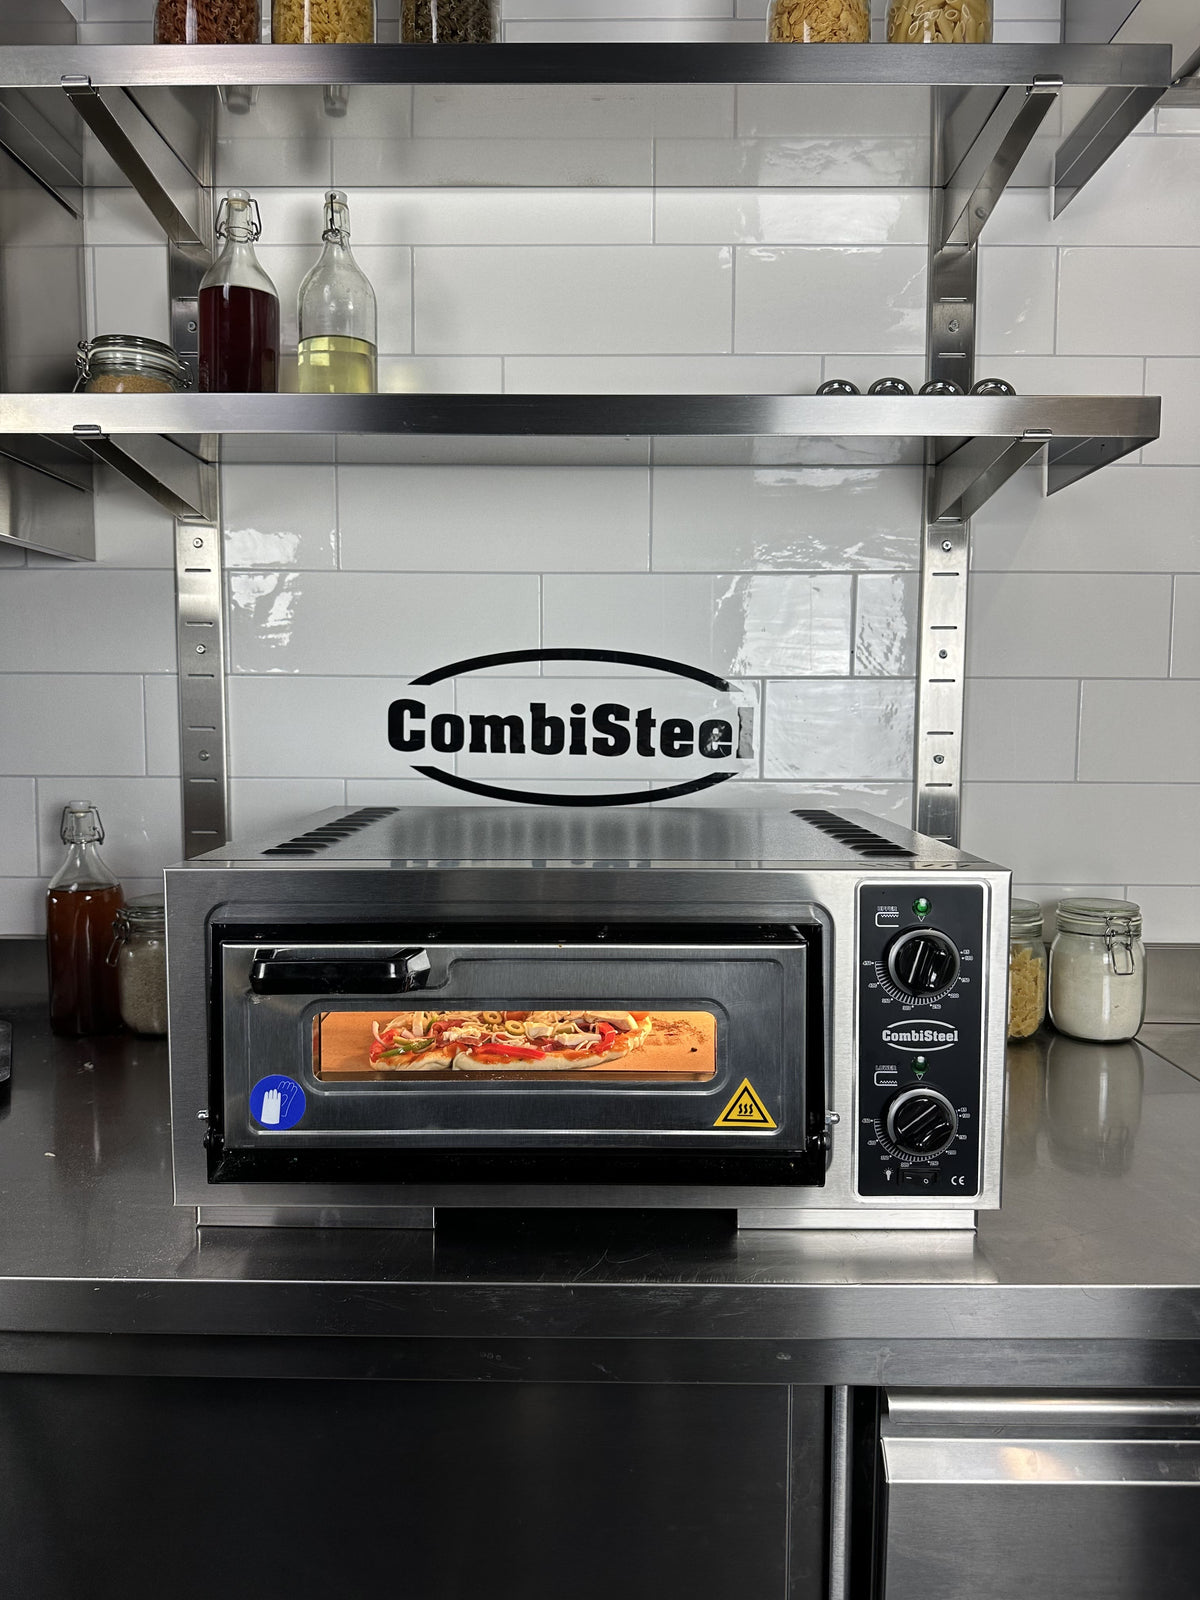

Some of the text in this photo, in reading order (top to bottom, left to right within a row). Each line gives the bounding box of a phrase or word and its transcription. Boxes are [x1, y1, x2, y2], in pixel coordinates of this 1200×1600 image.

[388, 699, 754, 759] CombiSteel
[882, 1030, 958, 1042] CombiSteel
[951, 1176, 964, 1185] CE
